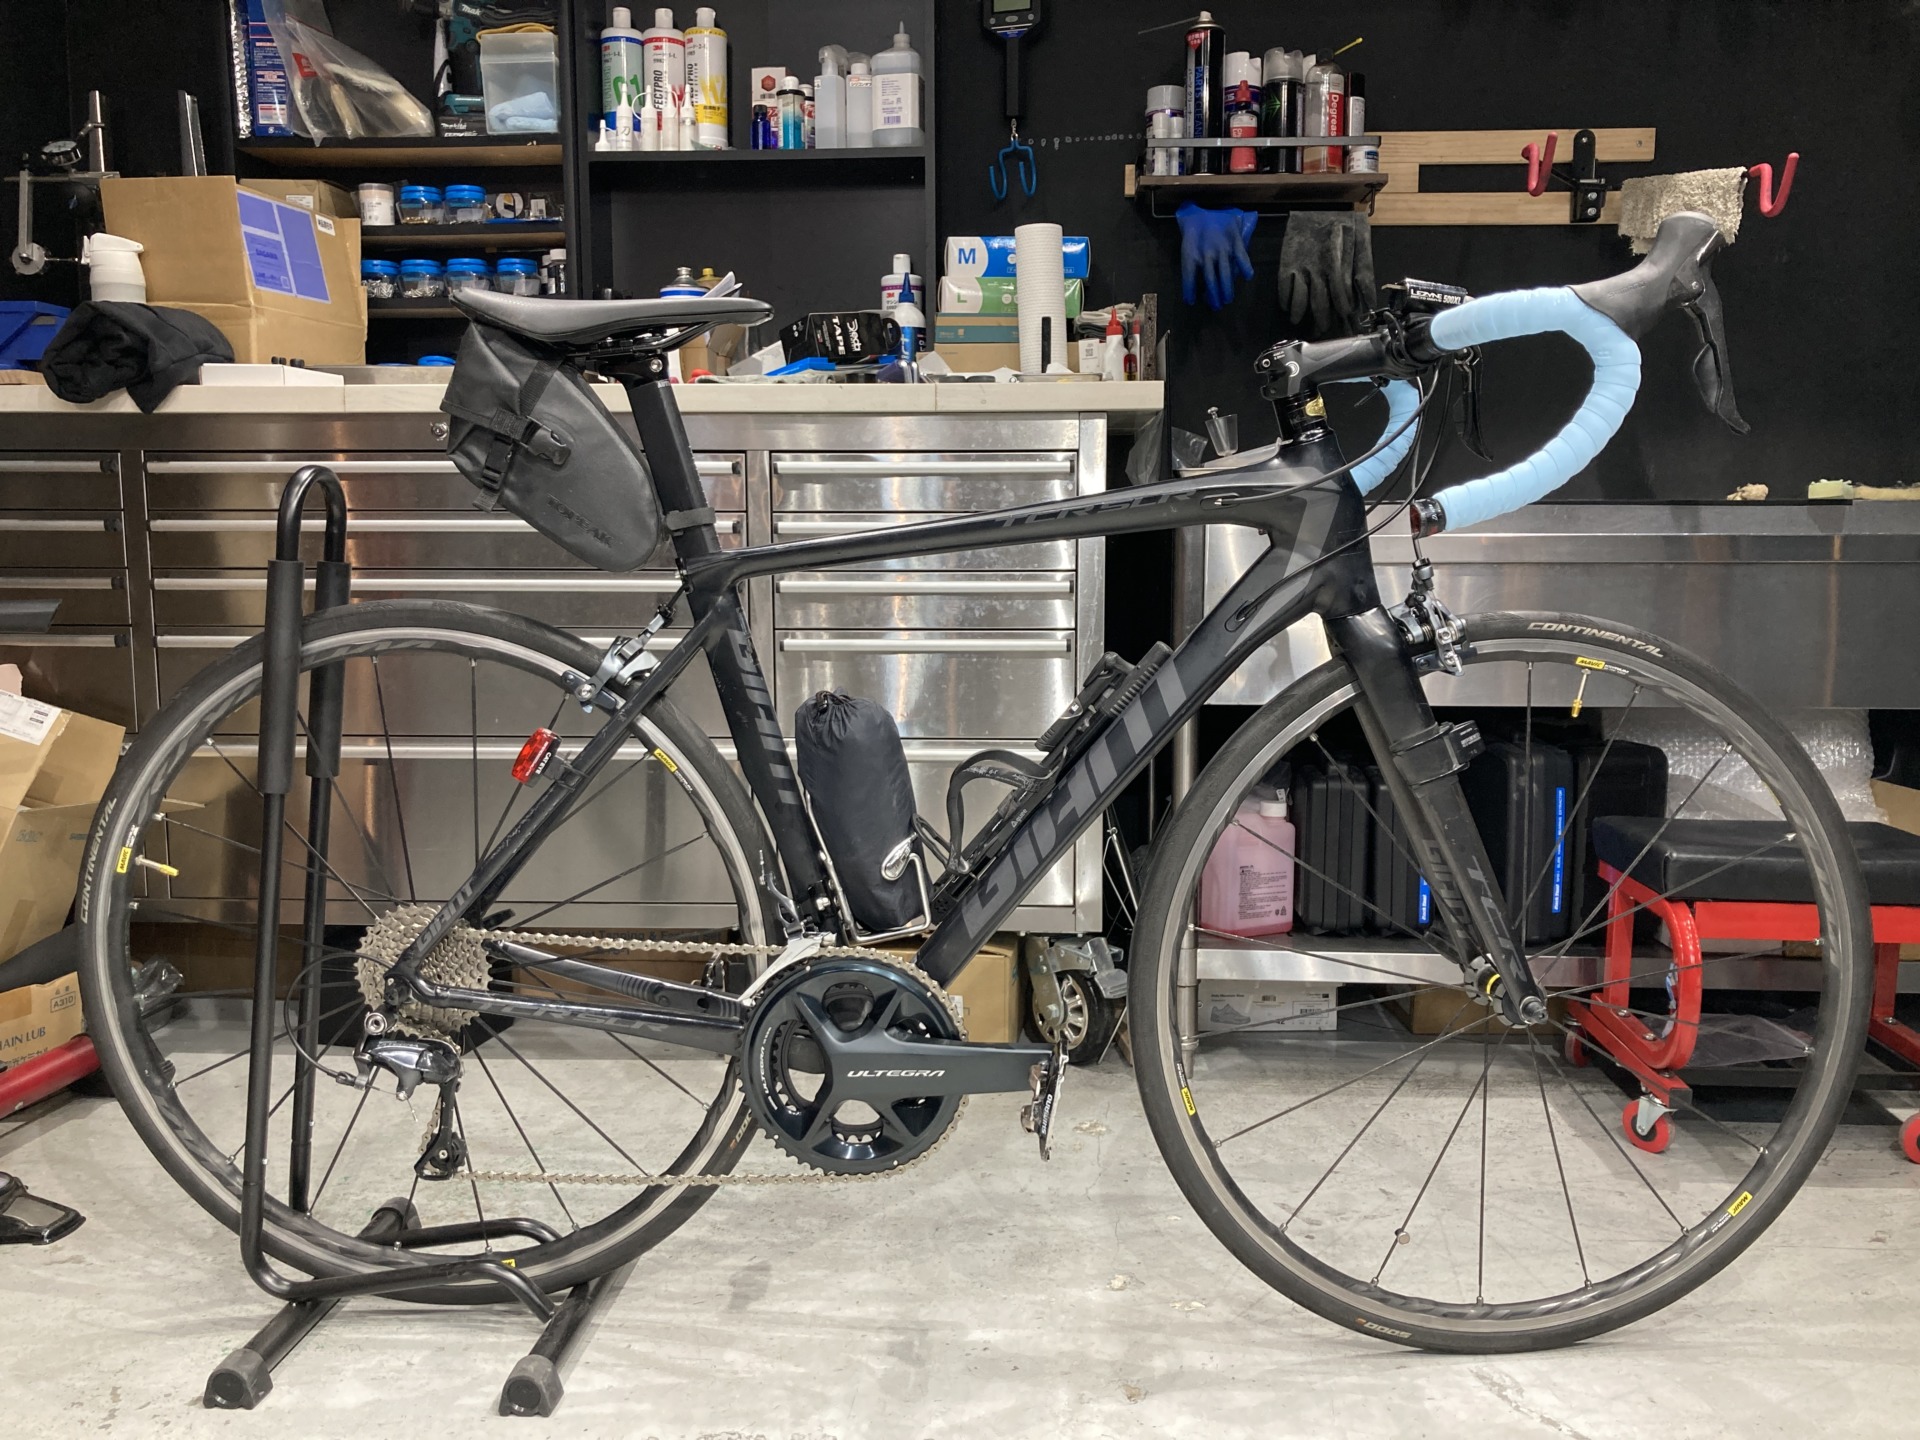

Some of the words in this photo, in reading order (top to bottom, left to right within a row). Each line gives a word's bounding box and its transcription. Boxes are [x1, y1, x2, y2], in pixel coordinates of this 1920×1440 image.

[1195, 66, 1204, 98] PARTS
[958, 248, 976, 264] M
[832, 315, 846, 355] TAPE
[1527, 622, 1664, 658] CONTINENTAL
[80, 797, 117, 924] CONTINENTAL
[847, 1069, 945, 1078] ULTEGRA
[1041, 1093, 1053, 1135] SHIMANO
